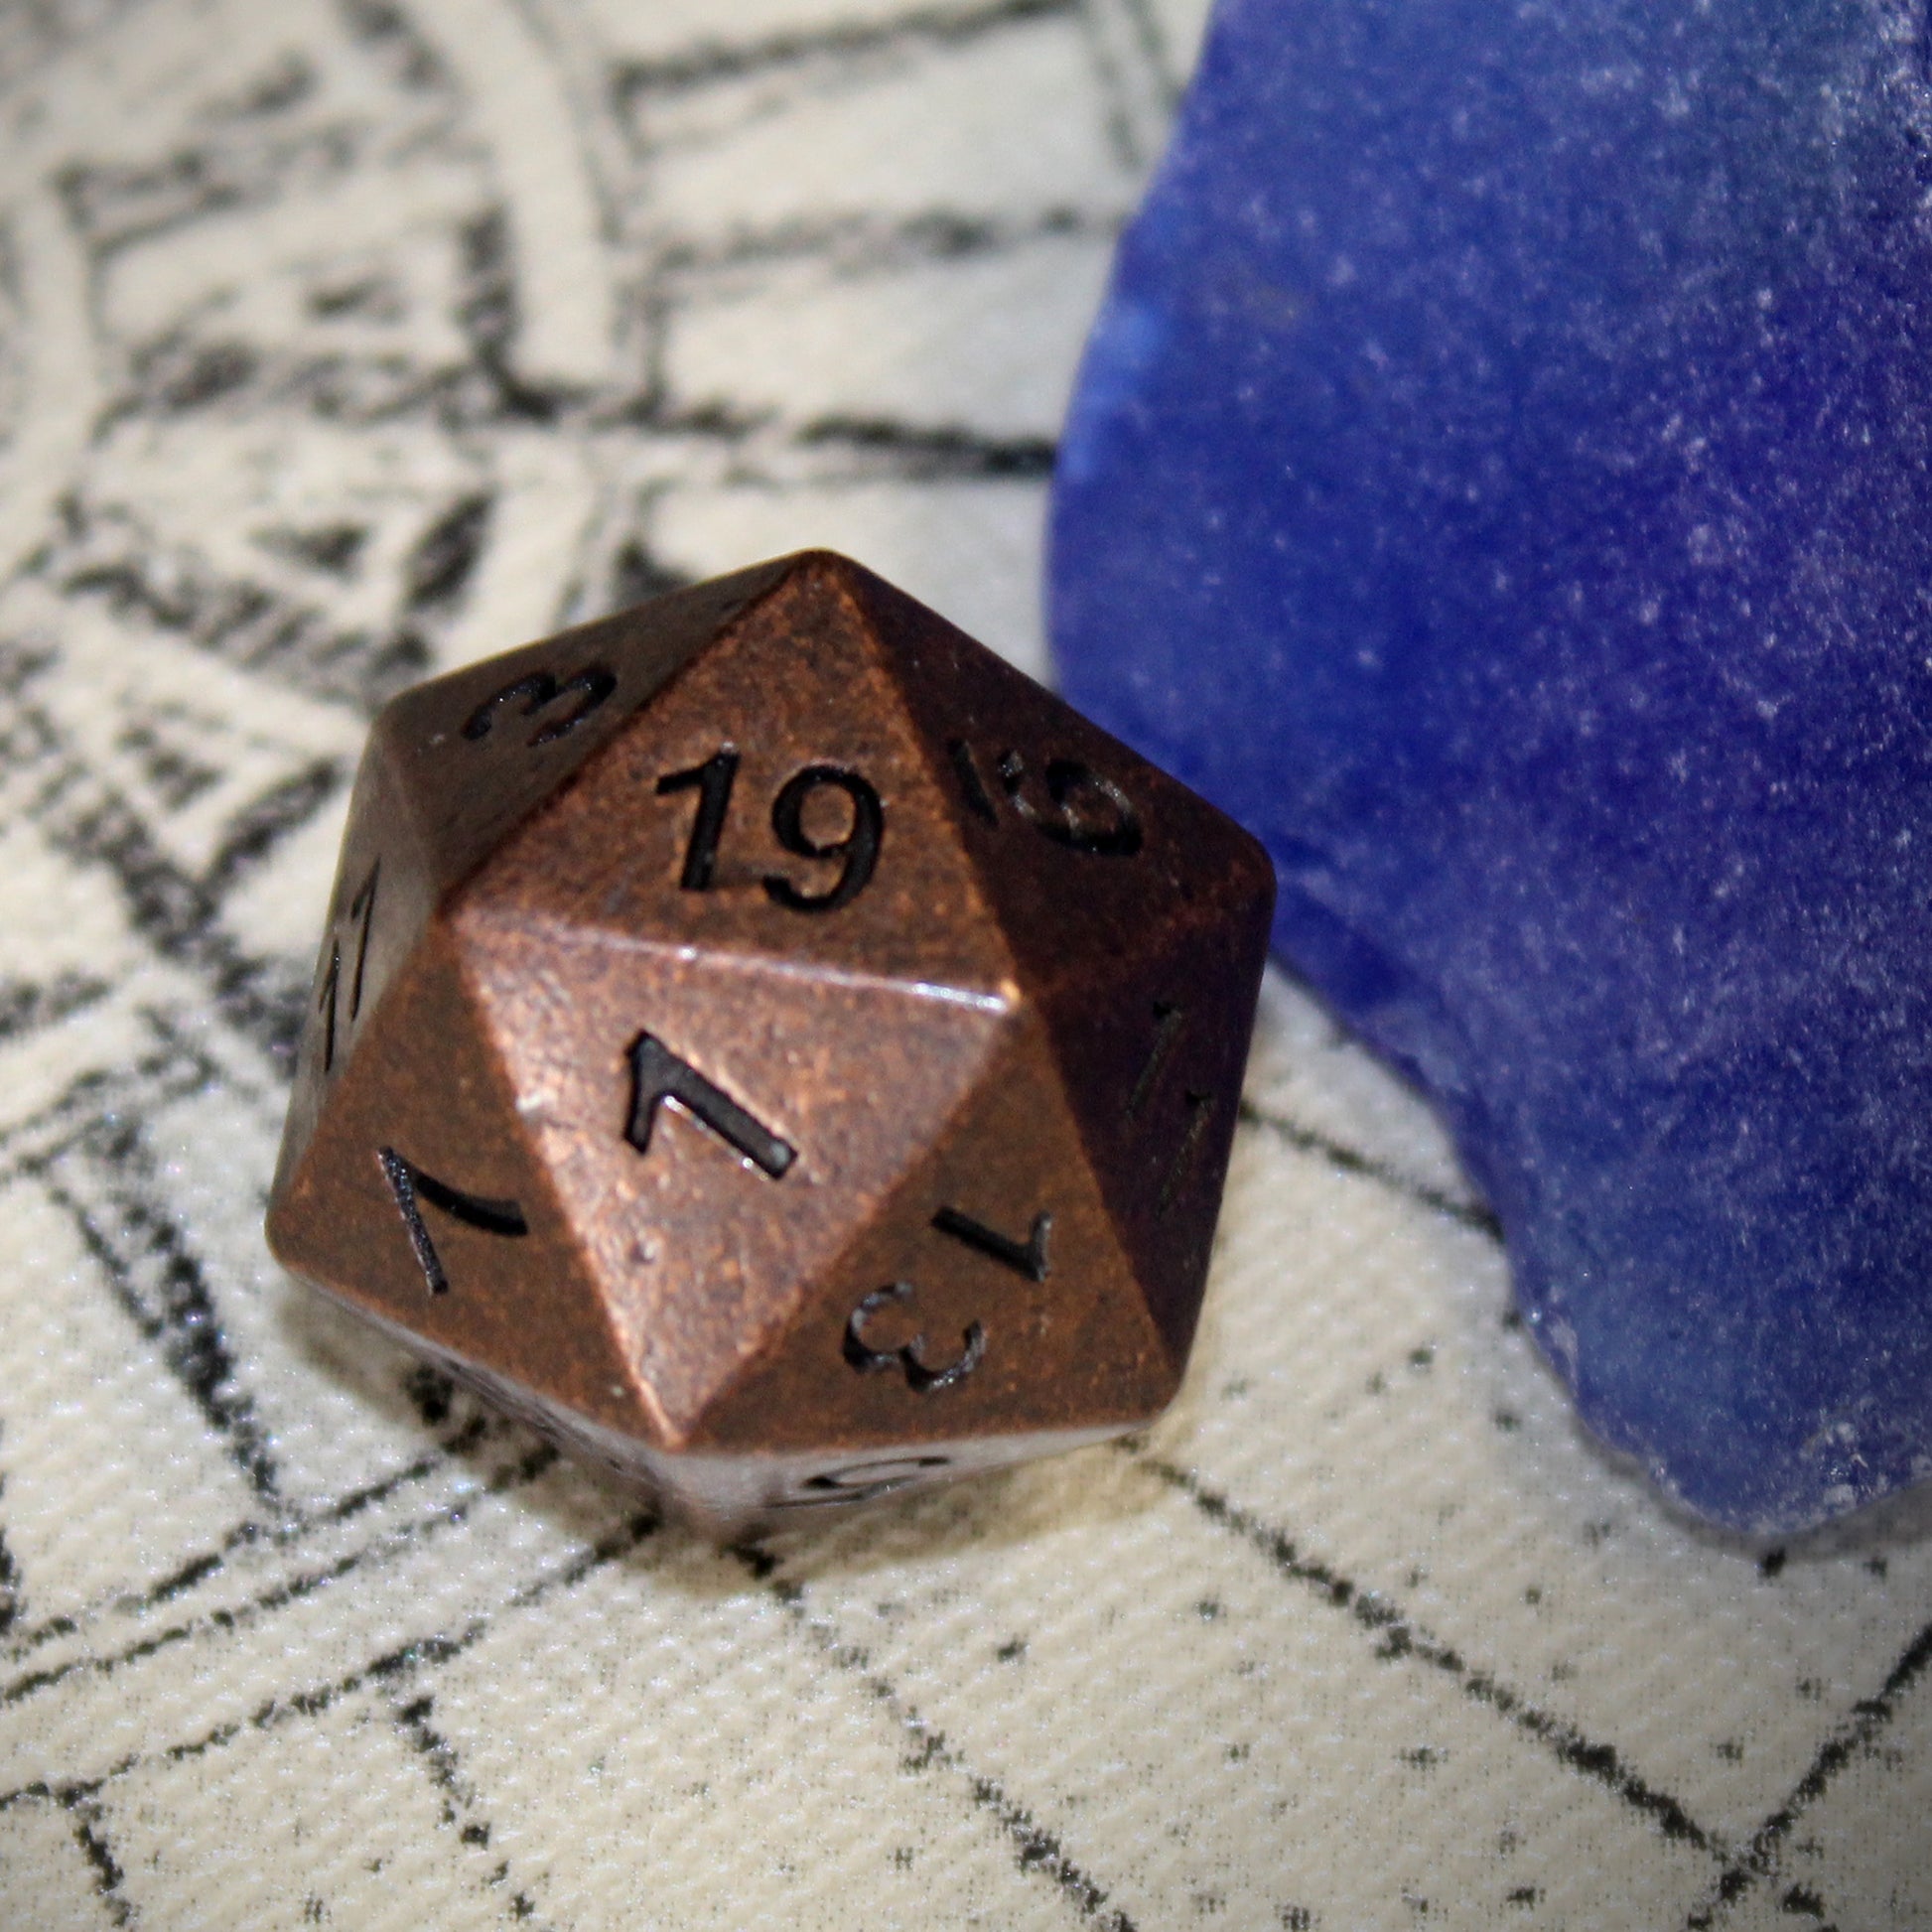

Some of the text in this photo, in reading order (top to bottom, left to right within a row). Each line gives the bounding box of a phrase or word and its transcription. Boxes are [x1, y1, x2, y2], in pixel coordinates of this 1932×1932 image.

[460, 667, 618, 749] 3
[655, 742, 885, 913] 19
[623, 1029, 798, 1180] 1
[377, 1146, 529, 1297] 7
[842, 1205, 1054, 1392] 13
